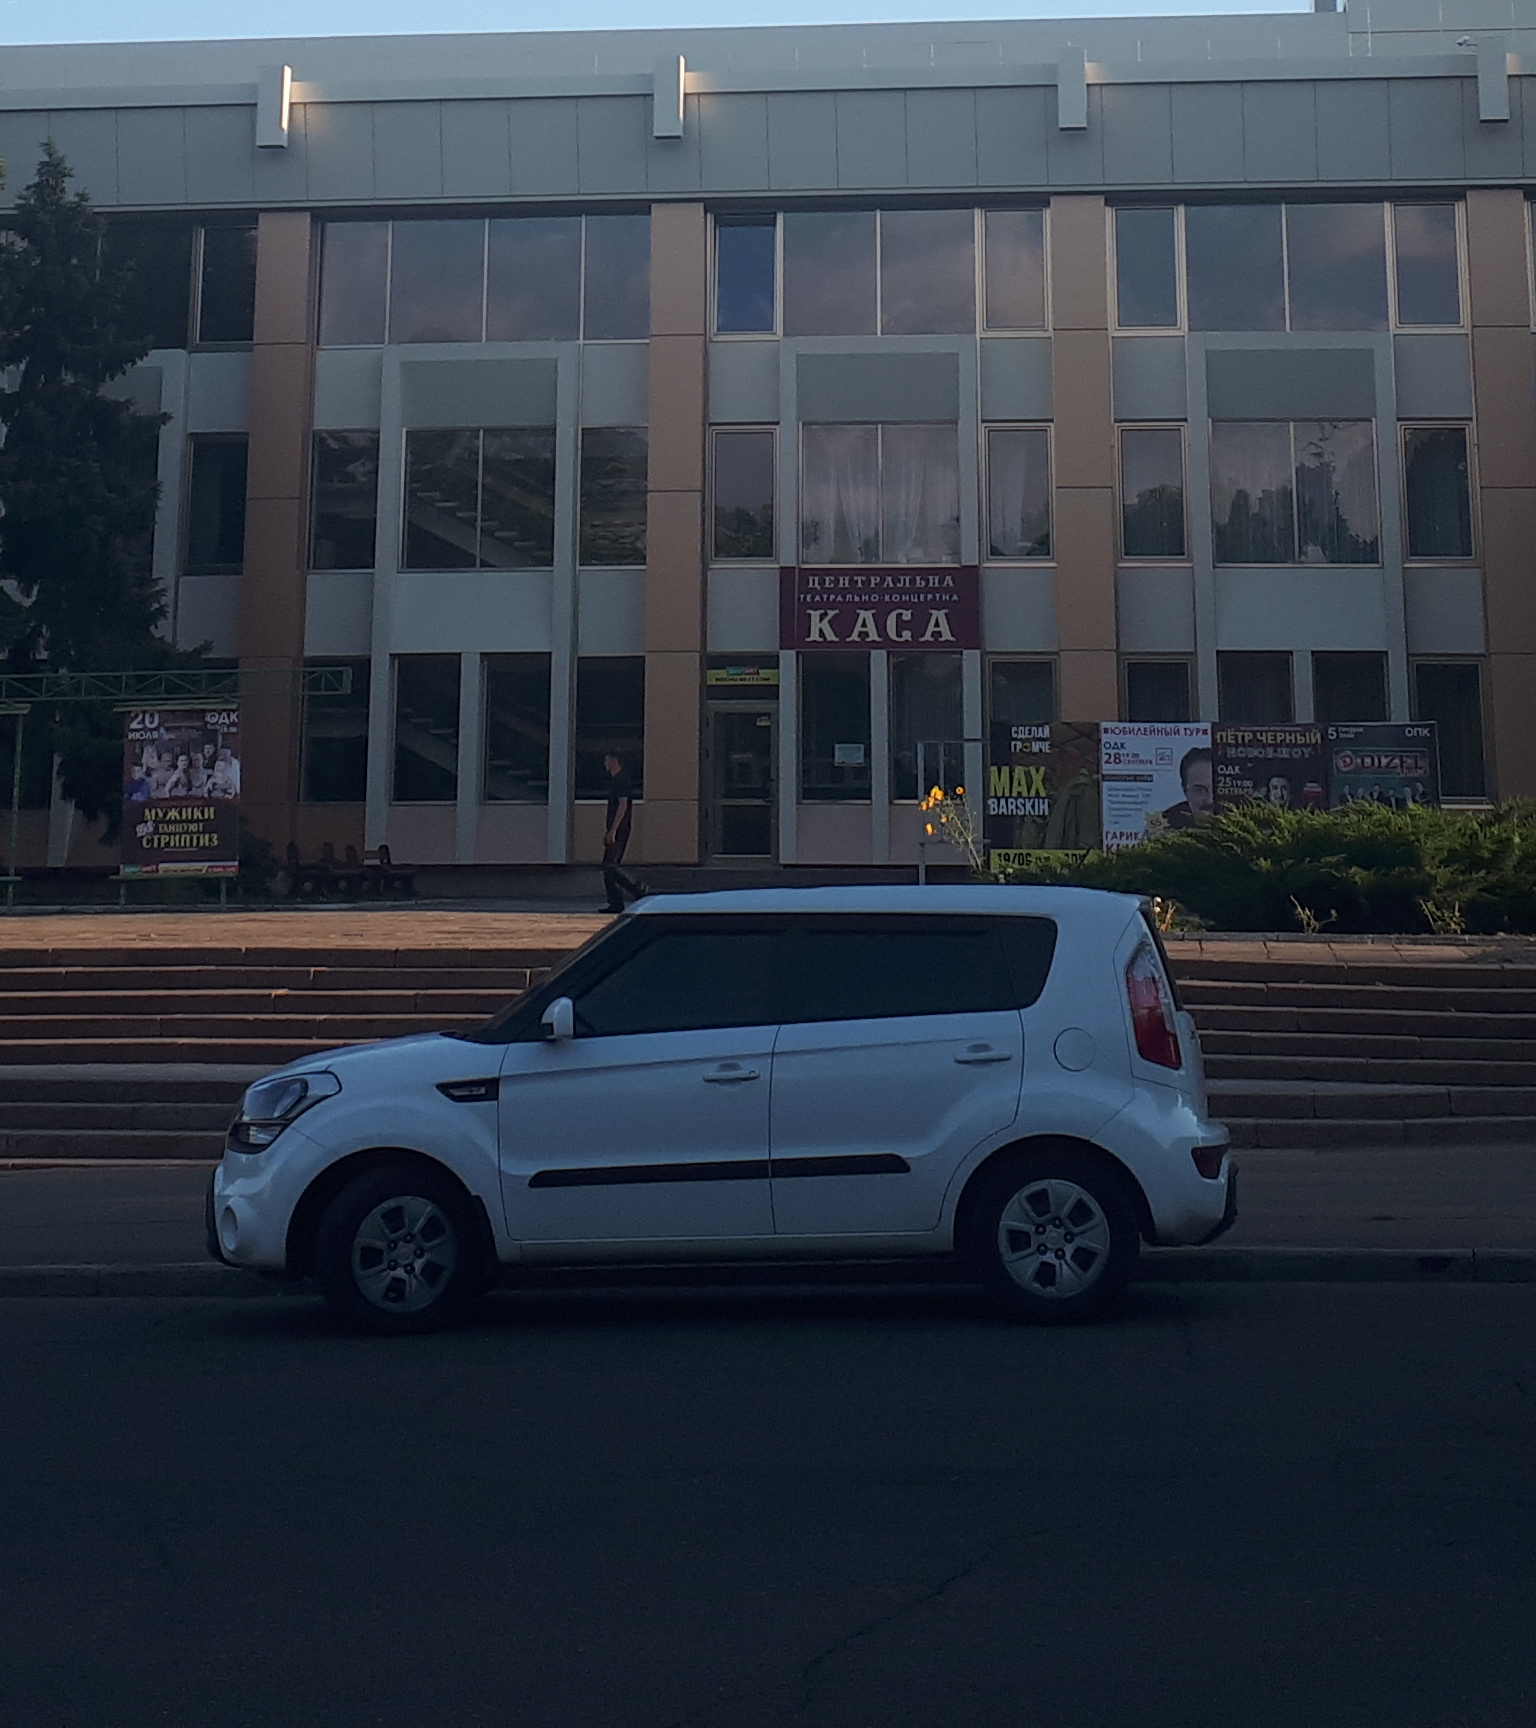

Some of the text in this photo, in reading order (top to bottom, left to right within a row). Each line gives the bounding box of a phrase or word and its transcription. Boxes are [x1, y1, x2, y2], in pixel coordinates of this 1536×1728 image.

[807, 575, 955, 590] ЦЕНТРАЛЬНА
[799, 593, 959, 603] ТЕАТРАЛЬНО-КОНЦЕРТНА
[804, 609, 957, 642] КАСА
[129, 710, 160, 730] 20
[206, 711, 239, 725] ОДК
[127, 731, 159, 740] ИЮЛЯ
[1011, 725, 1050, 739] СДЕЛАЙ
[1257, 728, 1322, 745] ЧЕРНЫЙ
[1327, 726, 1338, 740] 5
[1104, 742, 1126, 750] ОДК
[1104, 752, 1122, 765] 28
[1217, 765, 1241, 775] ОДК
[989, 765, 1047, 798] MAX
[1217, 776, 1232, 787] 25
[143, 806, 216, 821] МУЖИКИ
[987, 797, 1050, 816] BARSKIH
[158, 823, 205, 834] ТАНЦУЮТ
[141, 832, 219, 849] СТРИПТИЗ
